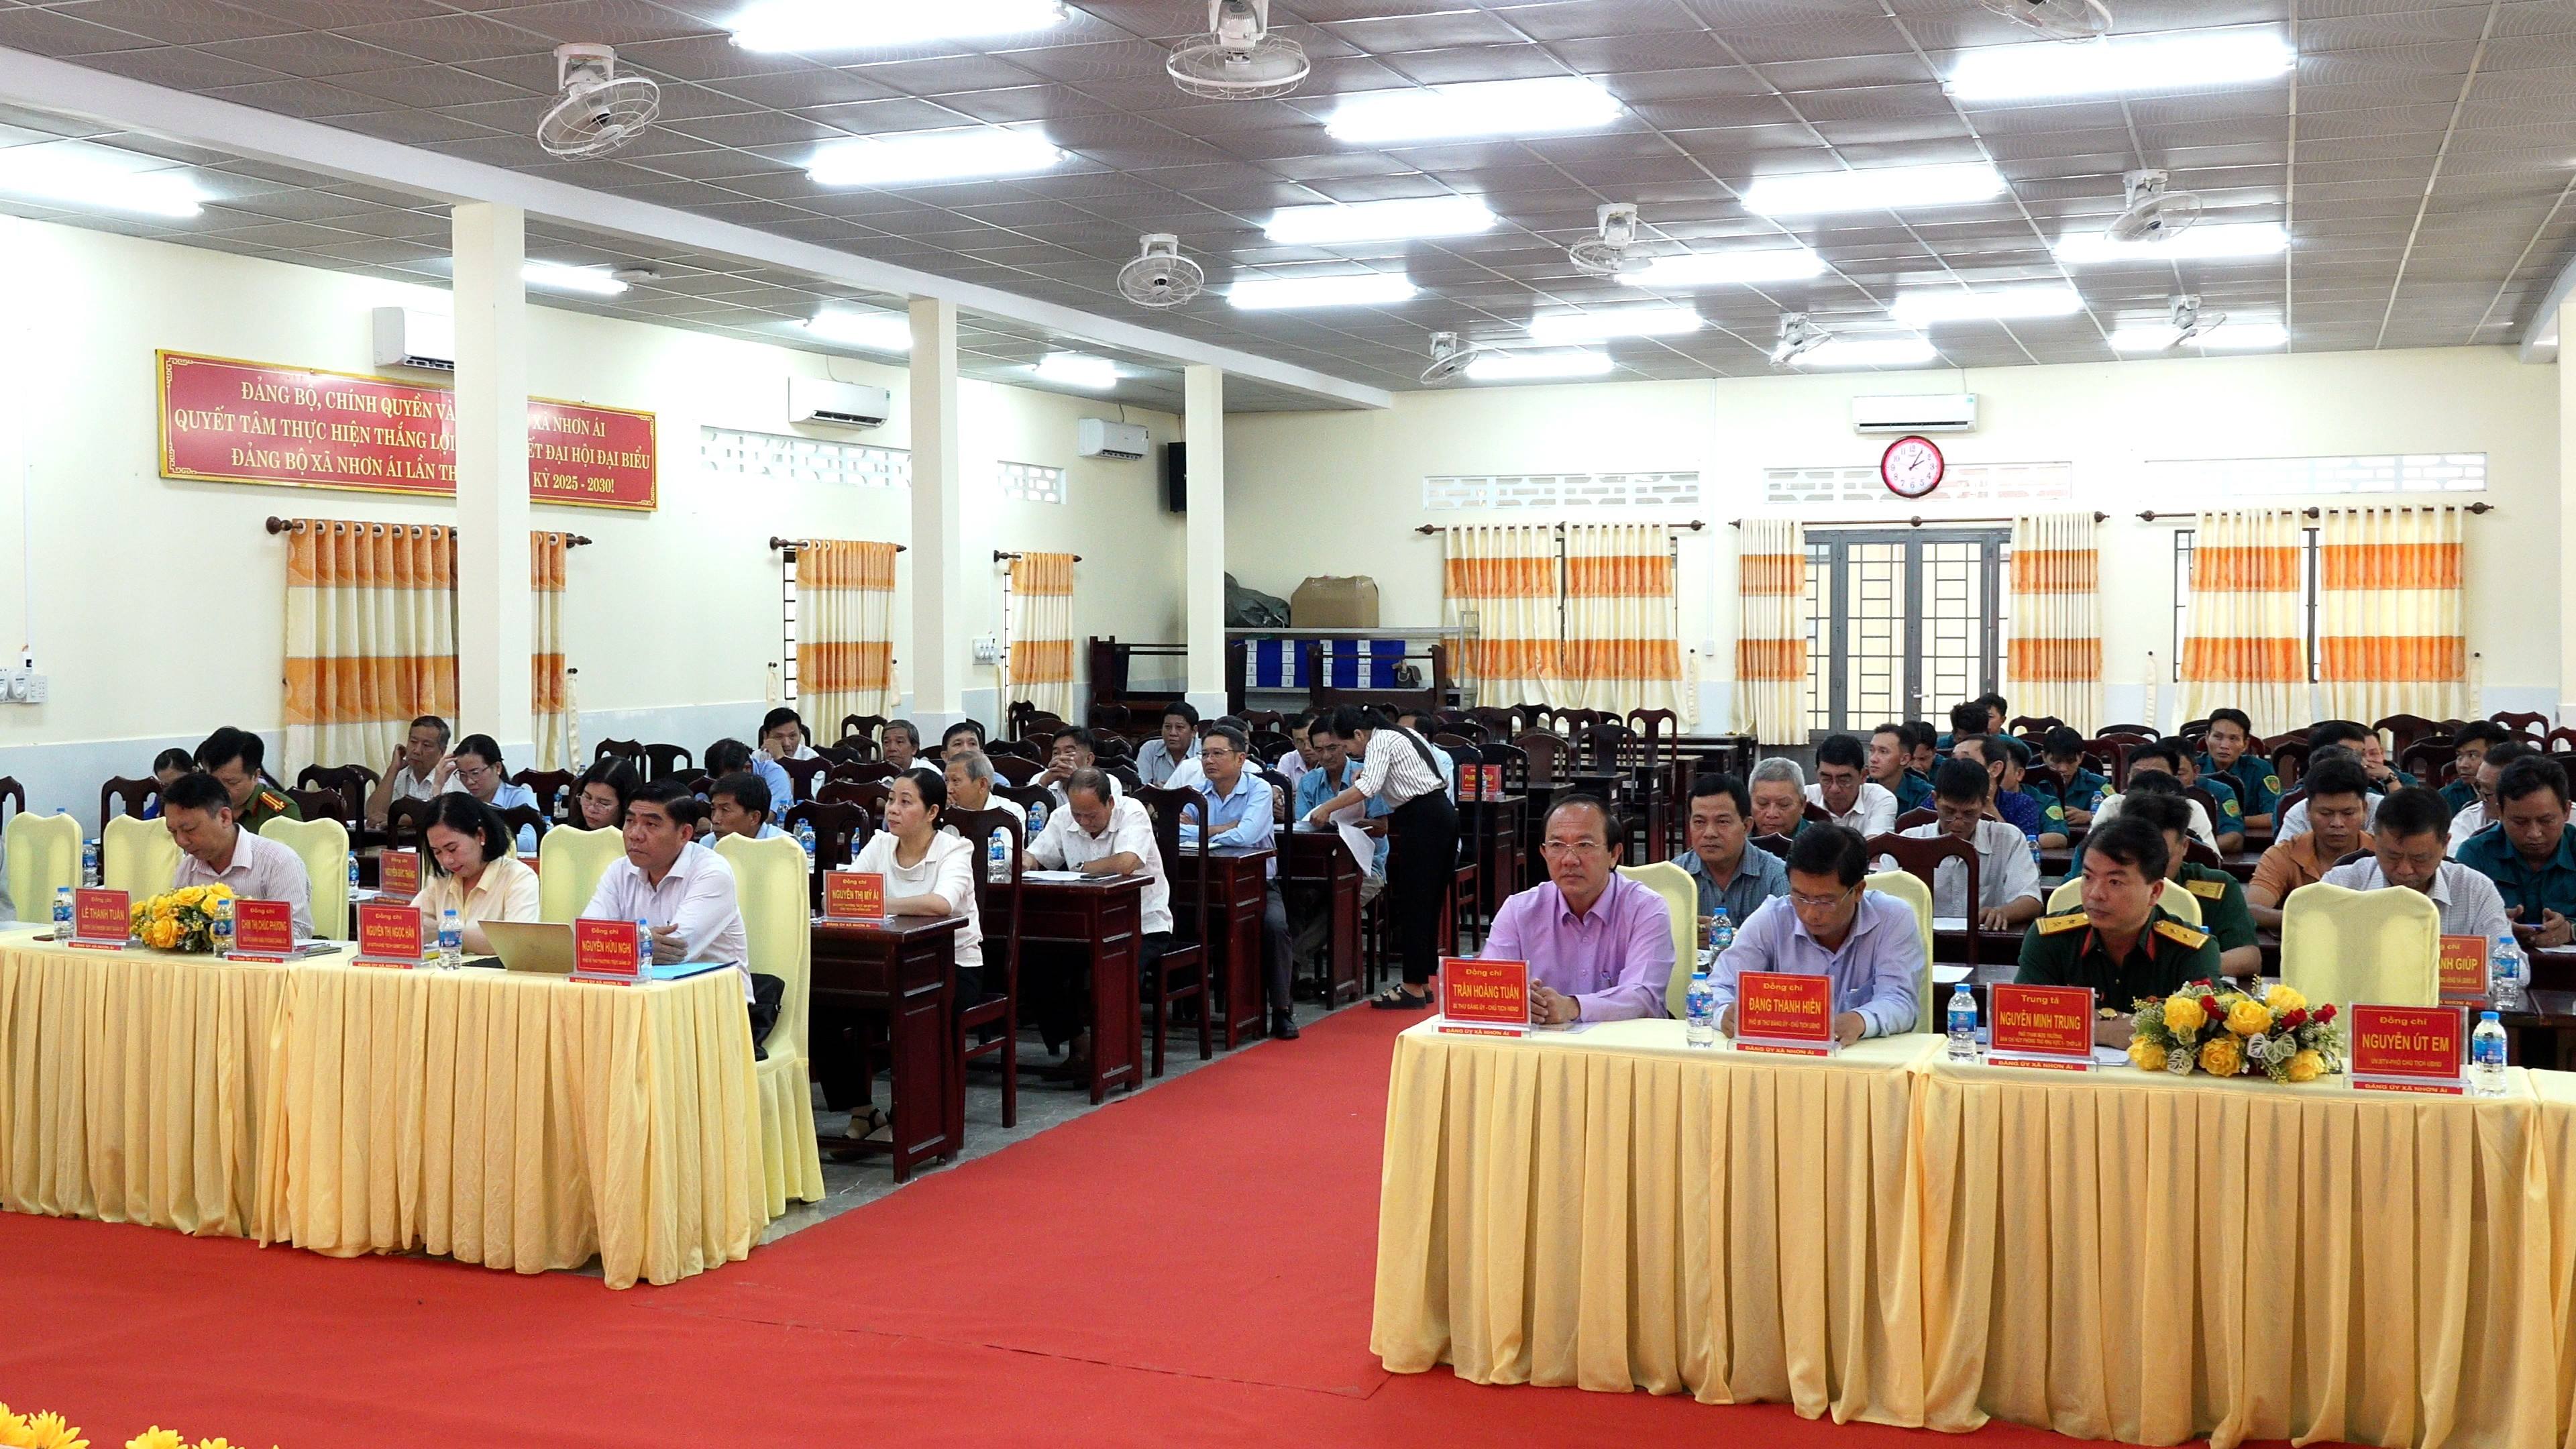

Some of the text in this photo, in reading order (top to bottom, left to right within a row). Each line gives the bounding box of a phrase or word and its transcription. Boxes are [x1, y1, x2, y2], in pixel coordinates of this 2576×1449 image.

[241, 376, 606, 437] ĐẢNG BỘ, CHÍNH QUYỀN VÀ XÃ NHƠN ÁI
[174, 405, 235, 432] QUYẾT
[239, 410, 276, 435] TÂM
[280, 419, 326, 443] THỰC
[331, 420, 370, 447] HIỆN
[374, 421, 427, 449] THẮNG
[430, 431, 455, 455] LỢI
[546, 444, 568, 465] ĐẠI
[572, 443, 595, 468] HỘI
[597, 449, 619, 470] ĐẠI
[622, 445, 650, 469] BIỂU
[231, 442, 280, 469] ĐẢNG
[286, 447, 309, 476] BỘ
[311, 450, 333, 472] XÃ
[337, 456, 382, 476] NHƠN
[386, 455, 402, 478] ÁI
[406, 454, 435, 480] LẦN
[439, 464, 456, 481] TH
[533, 468, 550, 488] KỲ
[553, 474, 578, 490] 2025
[588, 477, 614, 493] 2030!
[1466, 967, 1487, 977] Đồng
[1763, 981, 1787, 991] Đồng
[1774, 998, 1801, 1013] THANH
[2021, 994, 2059, 1005] Trung tá
[2000, 1009, 2081, 1030] NGUYỄN MINH TRUNG
[2379, 1016, 2408, 1026] Đồng
[2362, 1032, 2449, 1052] NGUYỄN ÚT EM
